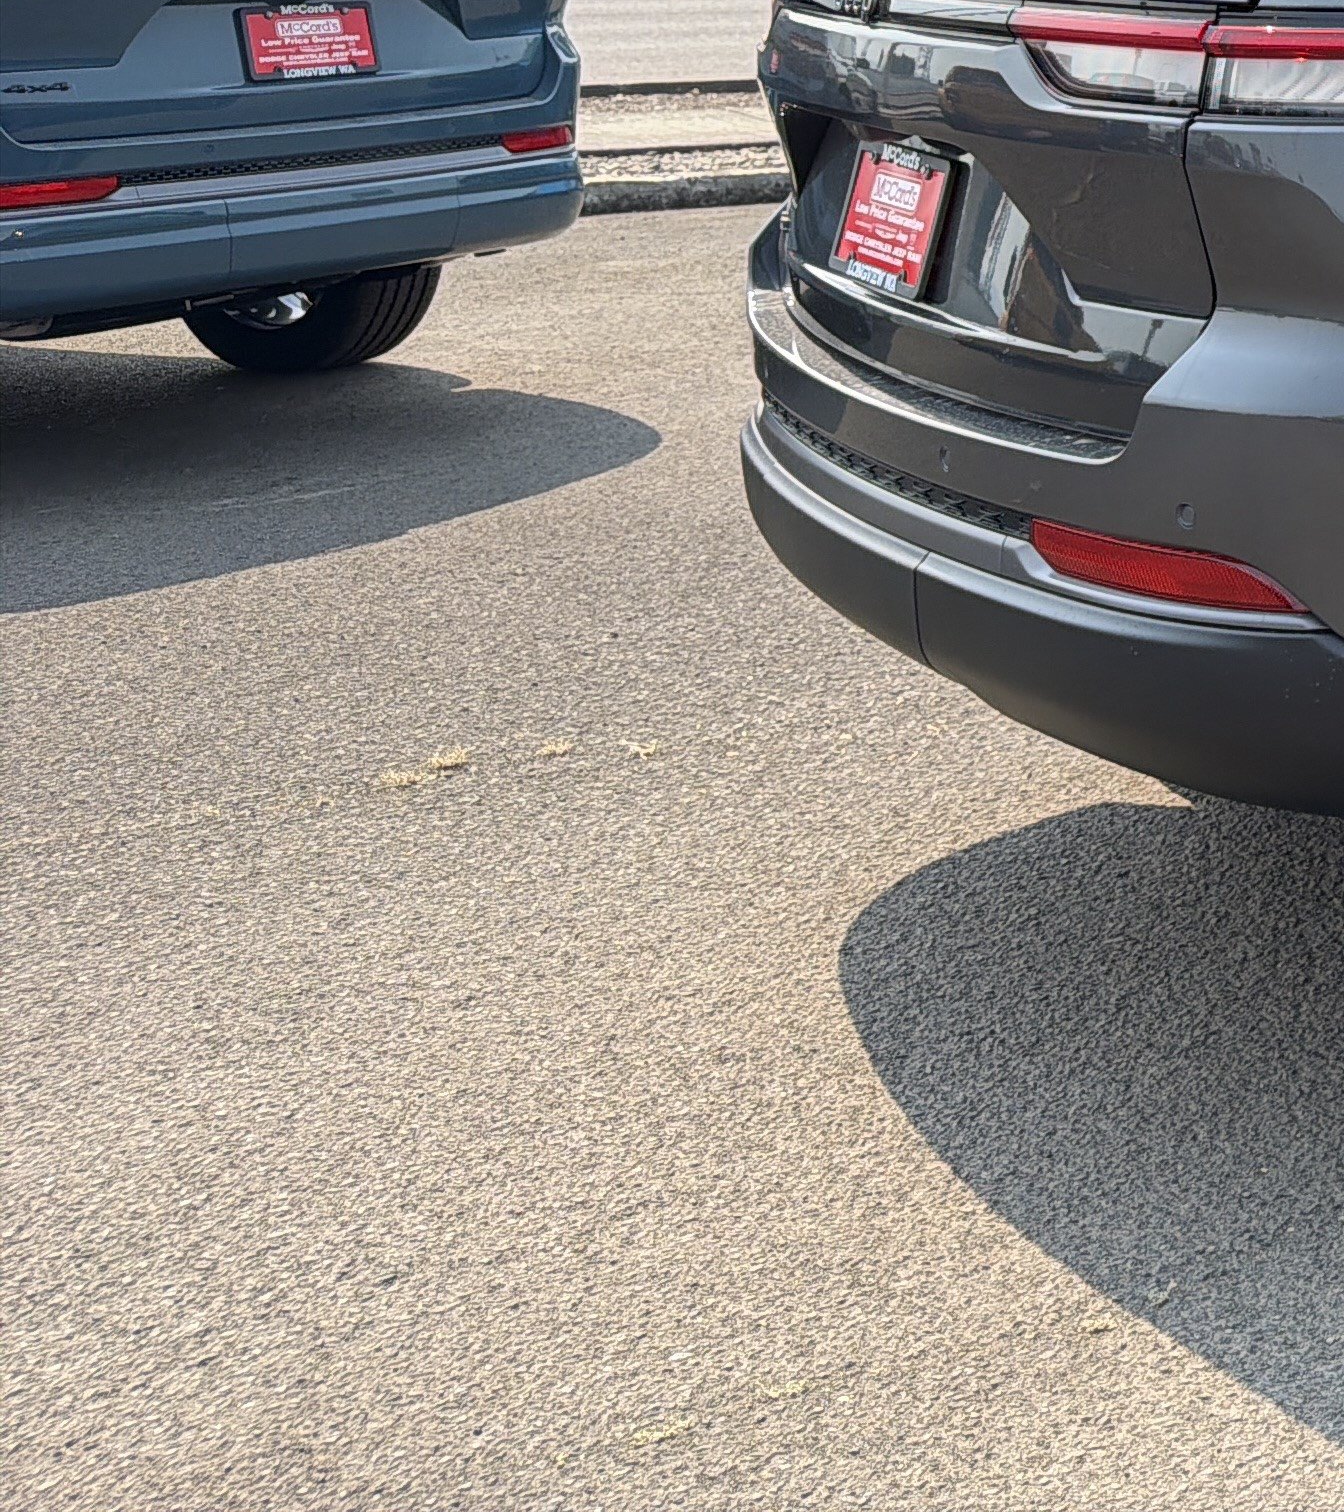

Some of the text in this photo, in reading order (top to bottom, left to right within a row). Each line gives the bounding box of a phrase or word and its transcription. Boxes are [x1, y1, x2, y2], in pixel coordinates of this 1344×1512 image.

[280, 3, 335, 15] McCord's
[279, 21, 339, 35] McCord's
[261, 34, 361, 47] Low Price Guarantee
[283, 64, 357, 79] LONGVIEW WA
